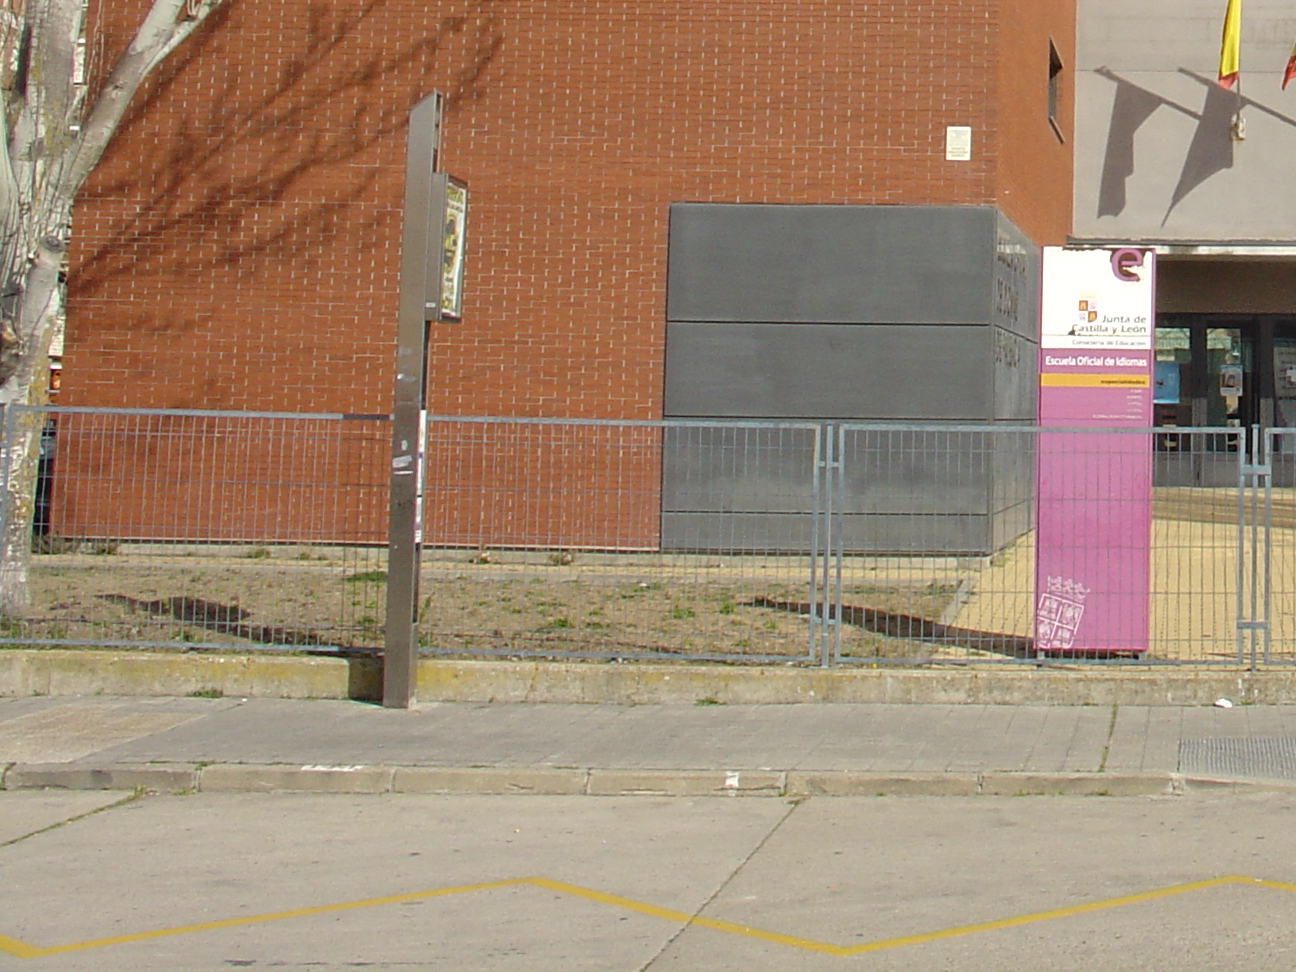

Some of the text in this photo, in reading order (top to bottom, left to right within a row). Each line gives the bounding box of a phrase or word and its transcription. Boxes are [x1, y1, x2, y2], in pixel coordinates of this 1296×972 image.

[1101, 315, 1147, 324] Junta de
[1071, 323, 1147, 335] Castilla y León
[1045, 355, 1147, 367] Escuela Oficial de Idiomas
